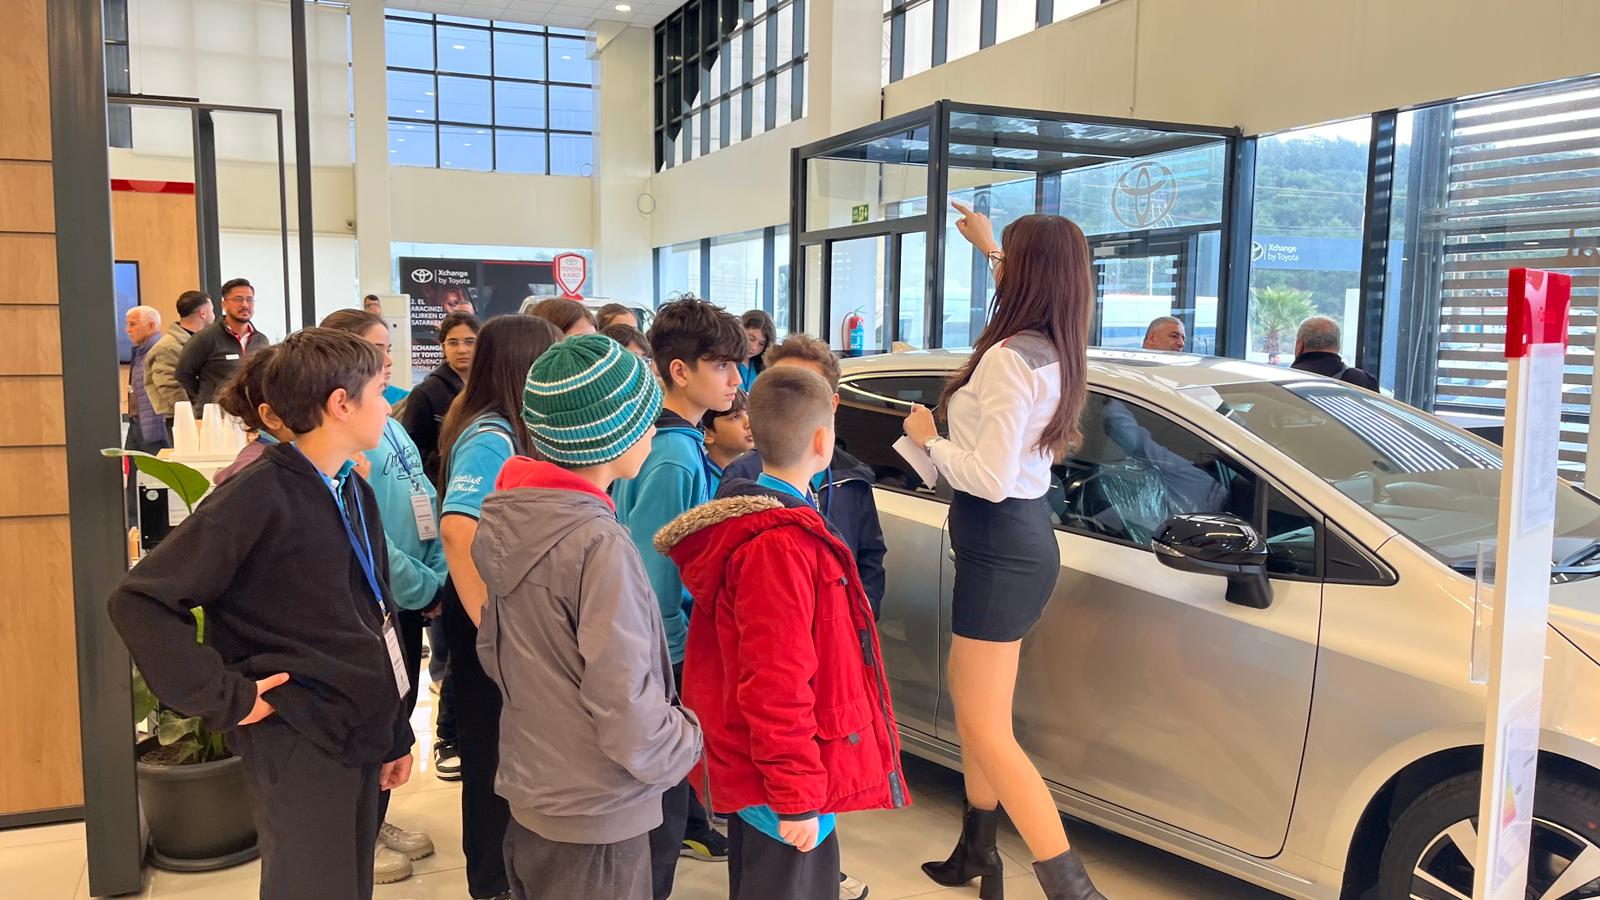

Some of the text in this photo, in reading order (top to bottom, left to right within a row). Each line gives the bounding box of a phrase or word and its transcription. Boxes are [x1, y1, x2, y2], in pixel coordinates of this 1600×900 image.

[1268, 243, 1297, 253] Xchange
[1267, 252, 1299, 262] by Toyota
[438, 269, 469, 278] Xchange
[438, 277, 471, 285] by Toyota
